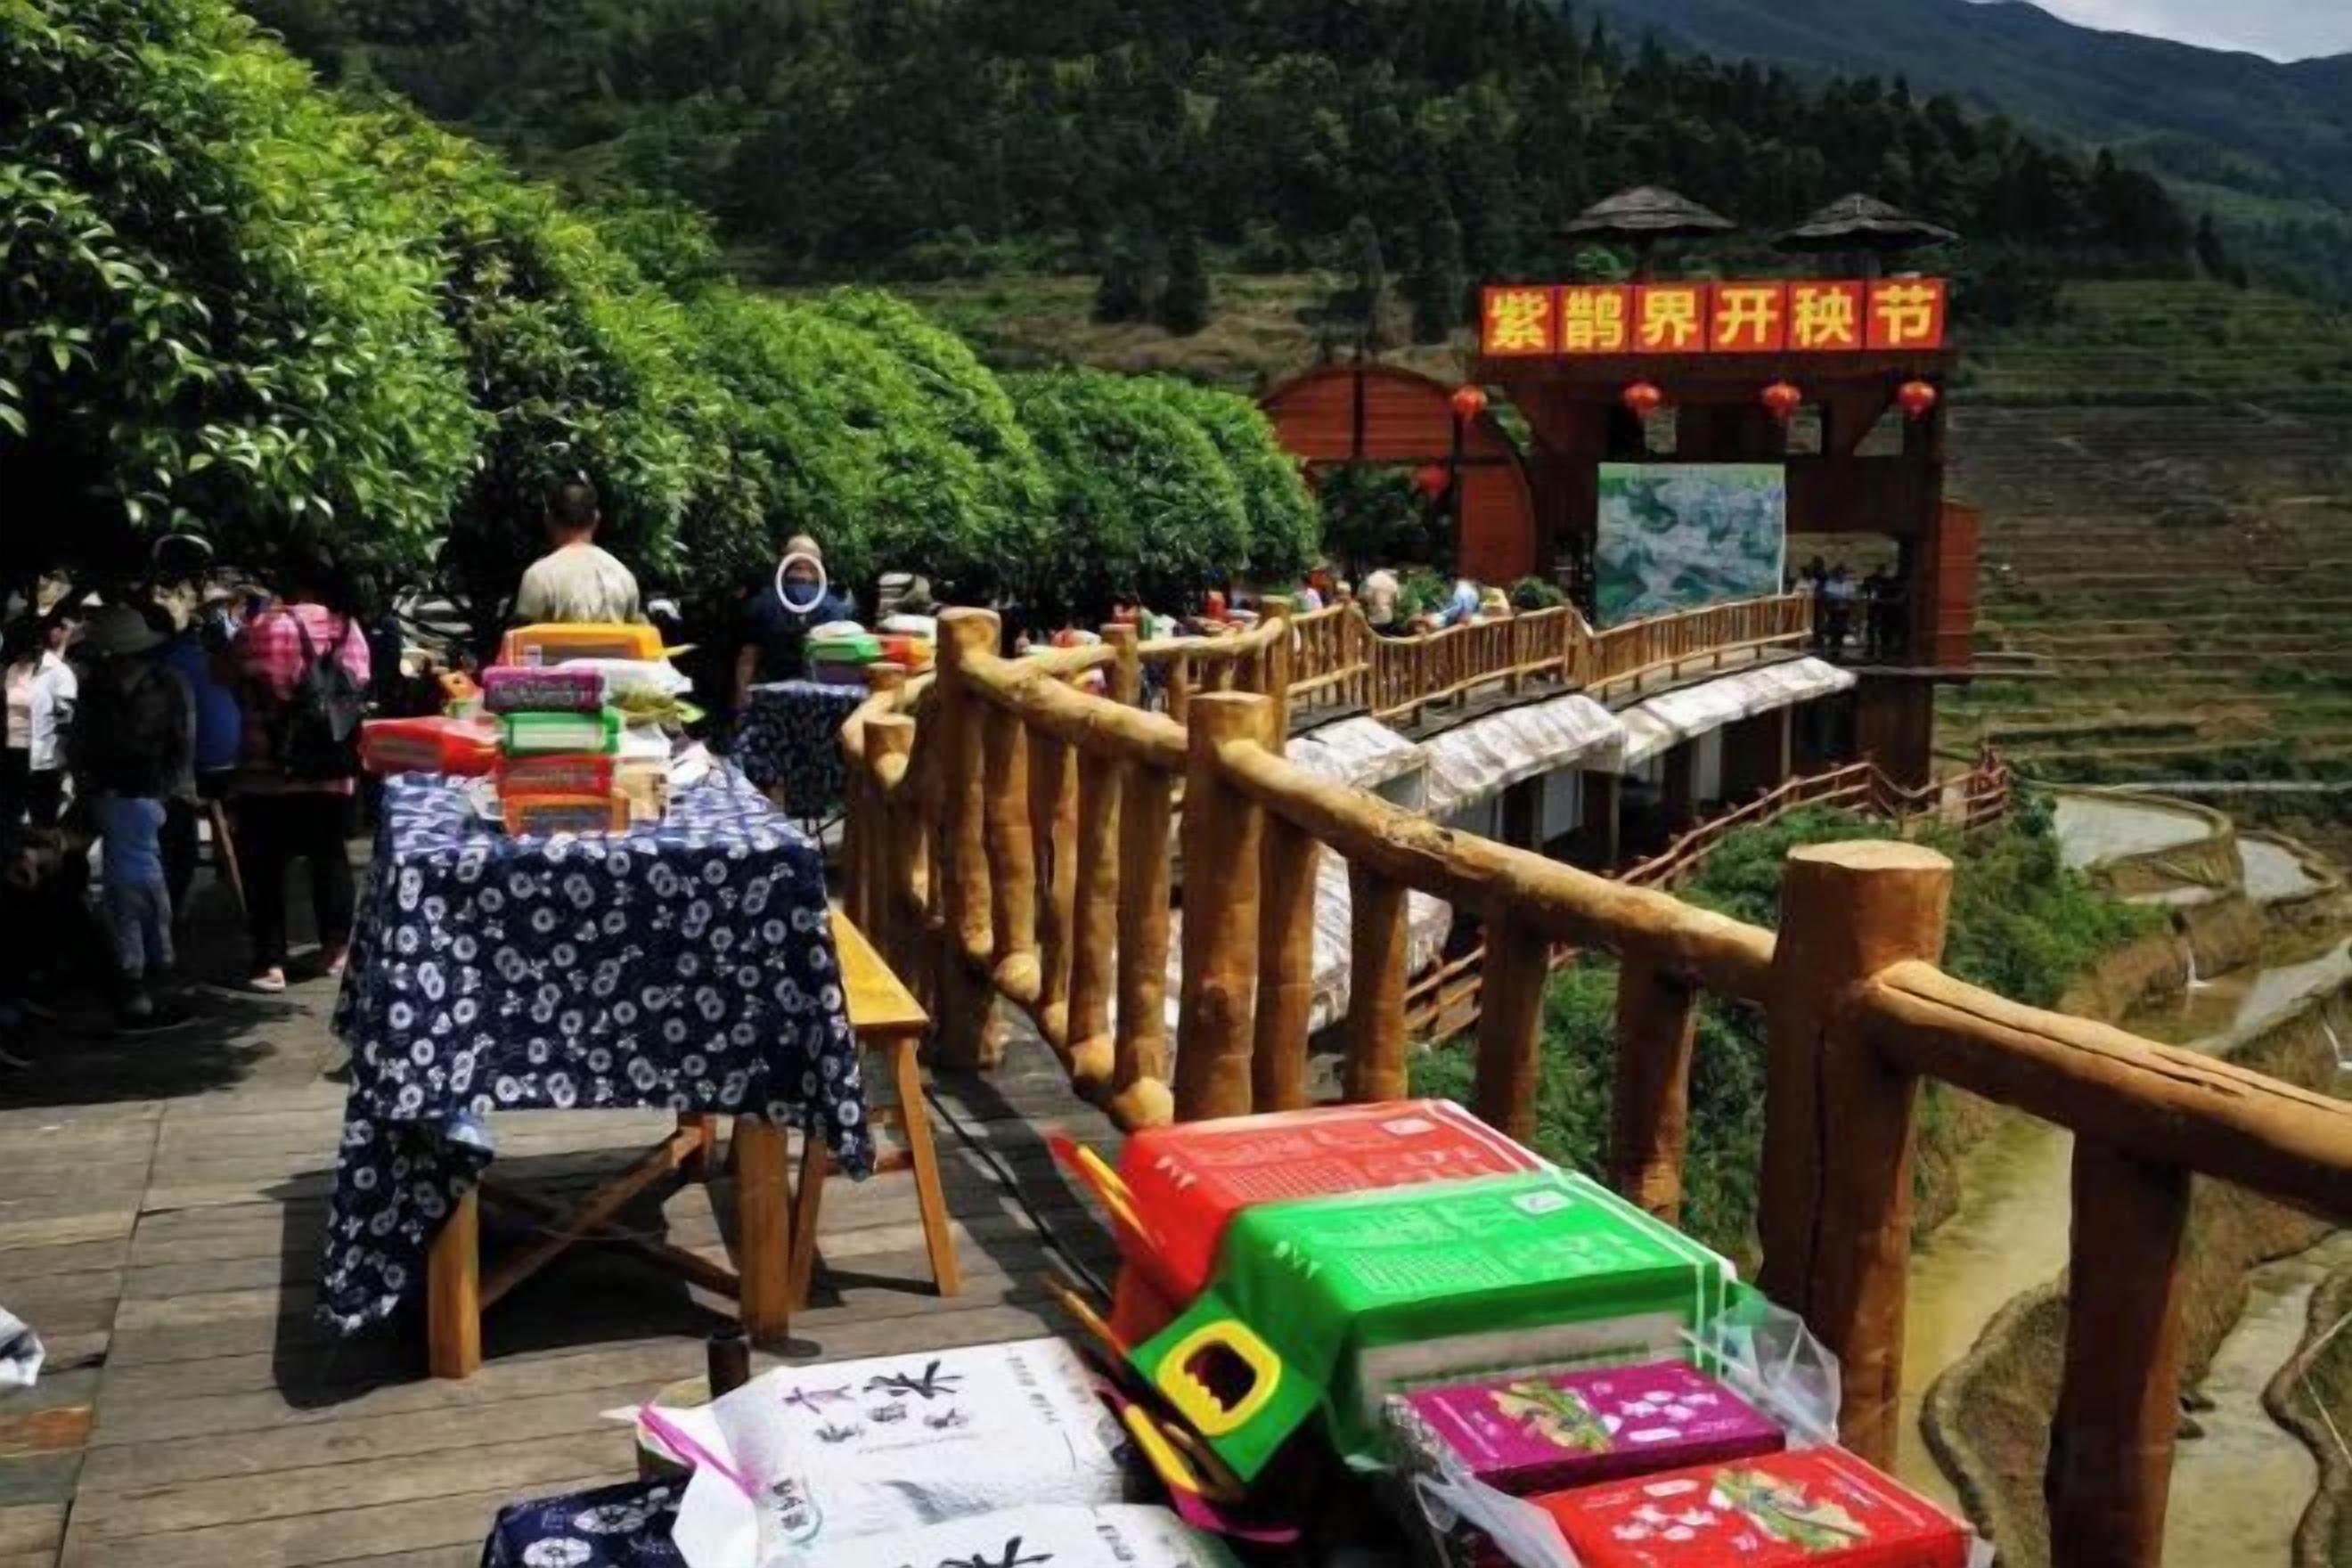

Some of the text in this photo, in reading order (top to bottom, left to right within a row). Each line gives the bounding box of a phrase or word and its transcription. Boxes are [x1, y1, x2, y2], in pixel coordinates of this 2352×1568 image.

[1490, 284, 1937, 349] 紫鹊界开秧节
